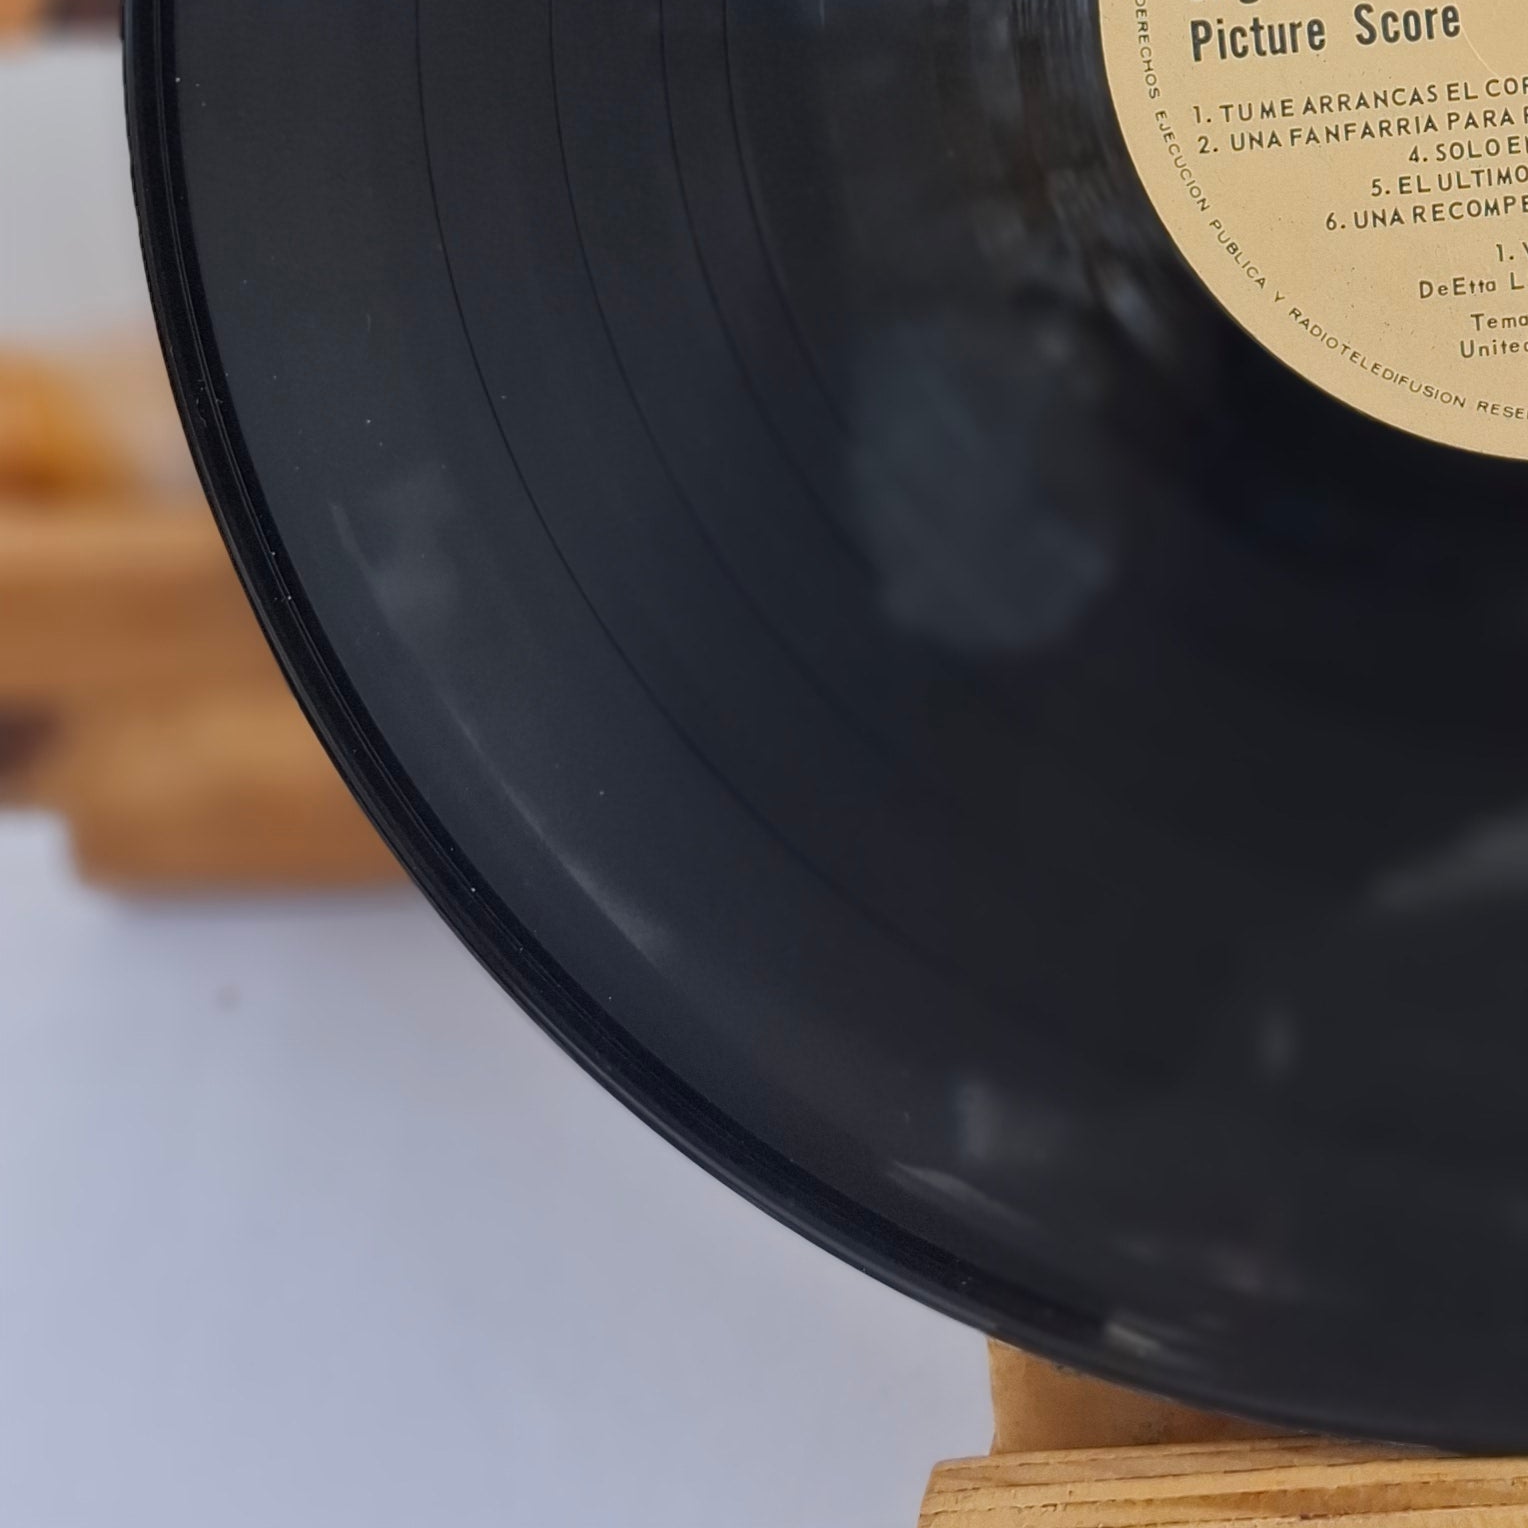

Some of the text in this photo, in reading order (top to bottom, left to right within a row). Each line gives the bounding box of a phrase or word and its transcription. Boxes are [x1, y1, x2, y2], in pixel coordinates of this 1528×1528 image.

[1190, 2, 1461, 62] Picture Score
[1302, 84, 1438, 116] ARRANCAS
[1448, 82, 1478, 101] EL
[1230, 130, 1282, 152] UNA
[1290, 114, 1438, 147] FANFARRIA
[1448, 107, 1515, 131] PARA
[1436, 138, 1500, 162] SOLO
[1399, 175, 1431, 195] EL
[1438, 164, 1528, 191] ULTIMO
[1353, 207, 1405, 229] UNA
[1155, 110, 1210, 212] EJECUCION
[1209, 220, 1266, 289] PUBLICA
[1274, 291, 1285, 303] Y
[1289, 307, 1466, 408] RADIOTELEDIFUSION
[1419, 277, 1496, 299] DeEtta
